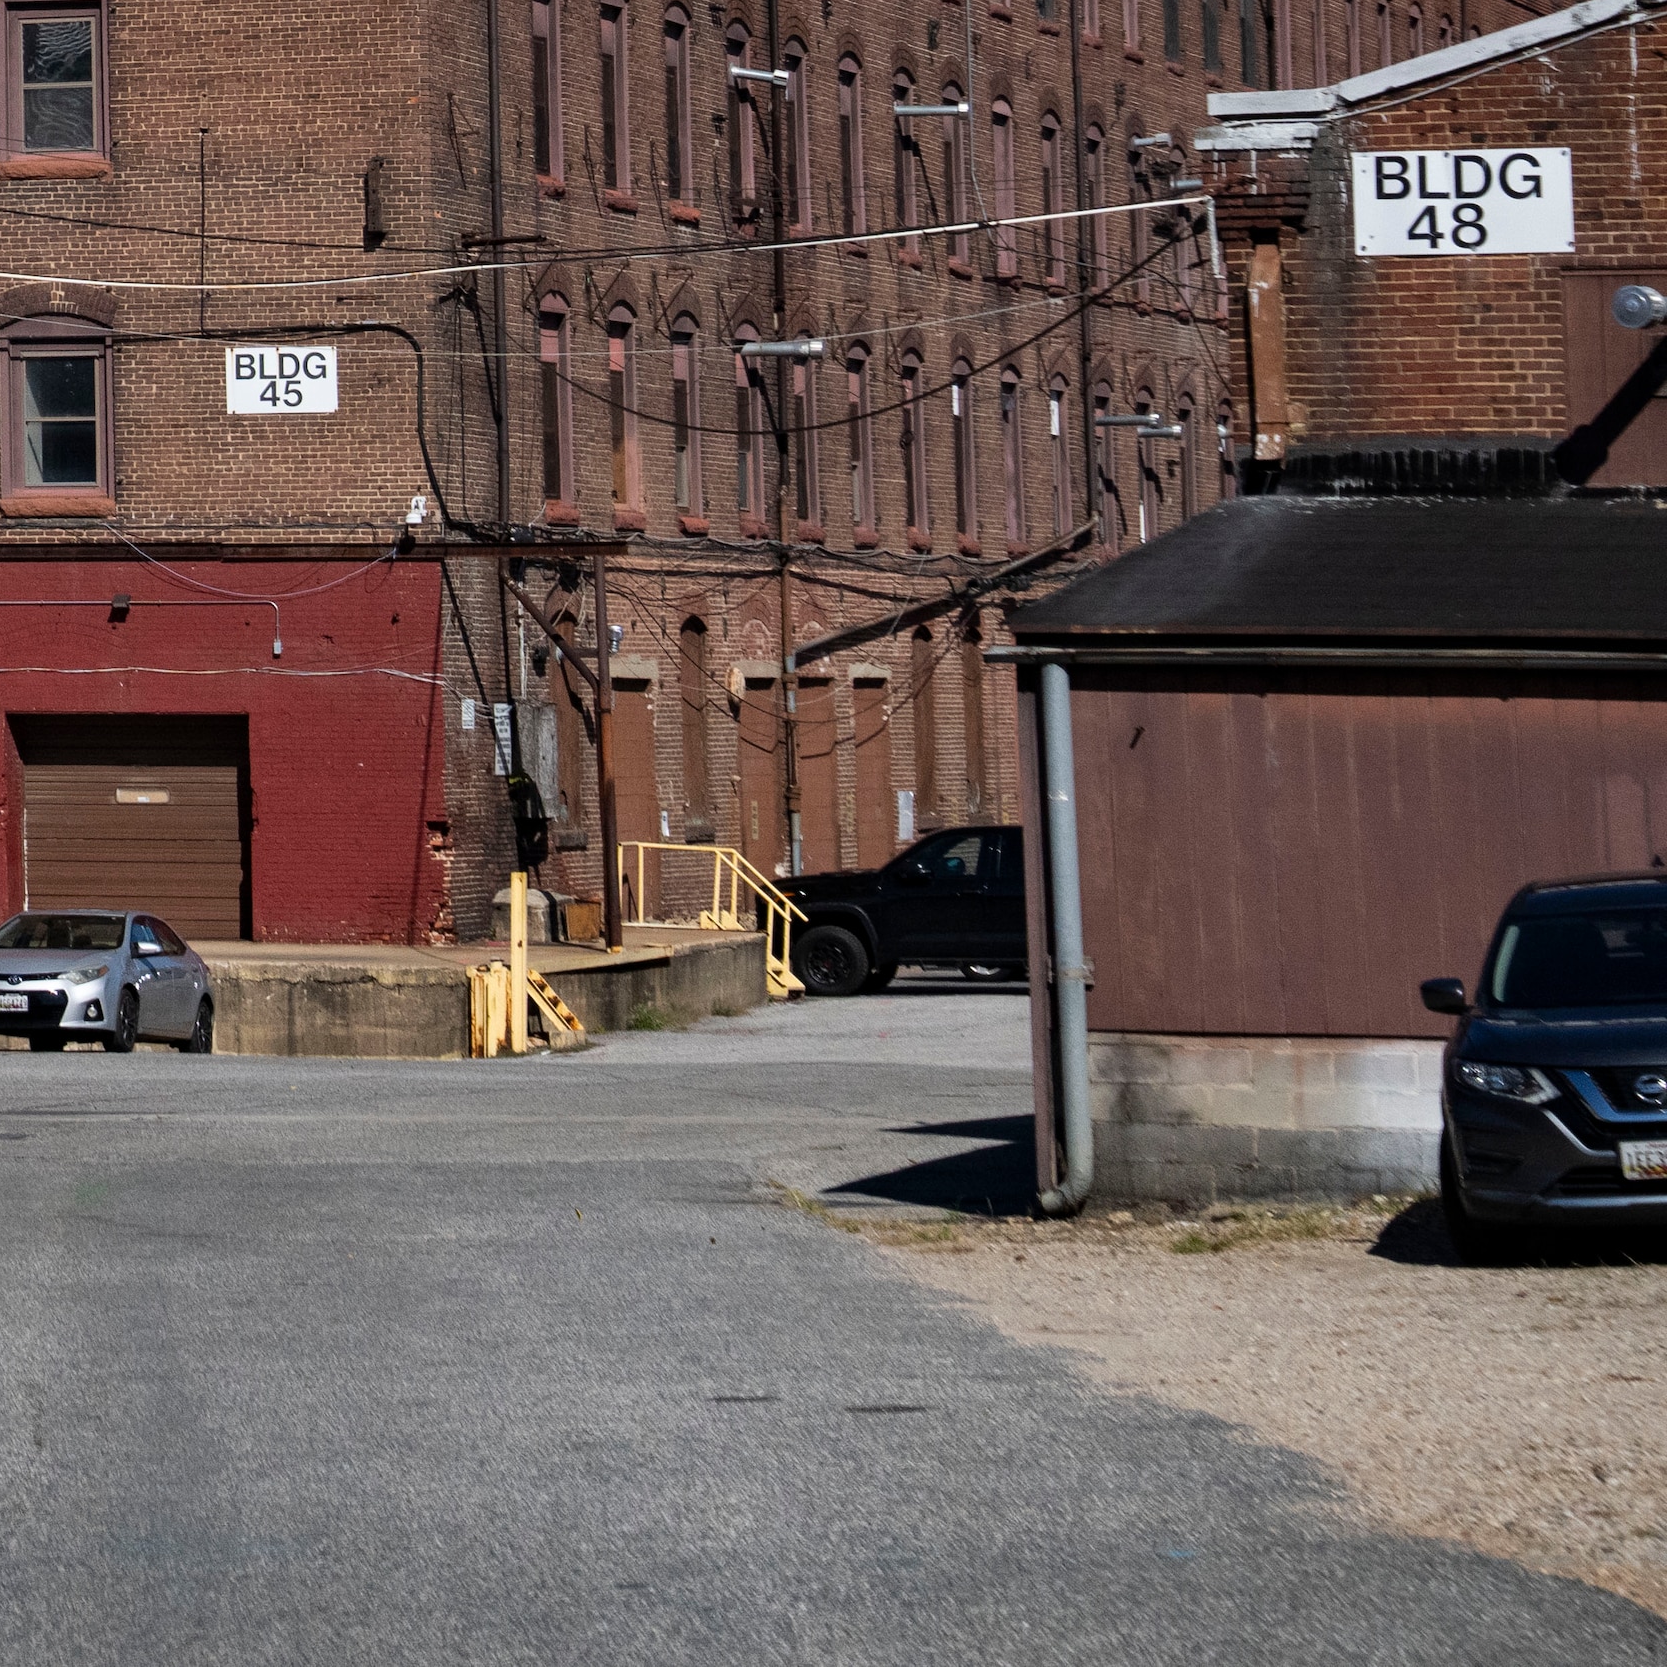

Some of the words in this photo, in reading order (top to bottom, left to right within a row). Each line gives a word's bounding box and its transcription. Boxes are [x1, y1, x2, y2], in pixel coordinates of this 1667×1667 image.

[1375, 153, 1542, 200] BLDG
[1407, 203, 1487, 249] 48
[235, 352, 327, 380] BLDG
[259, 380, 303, 407] 45
